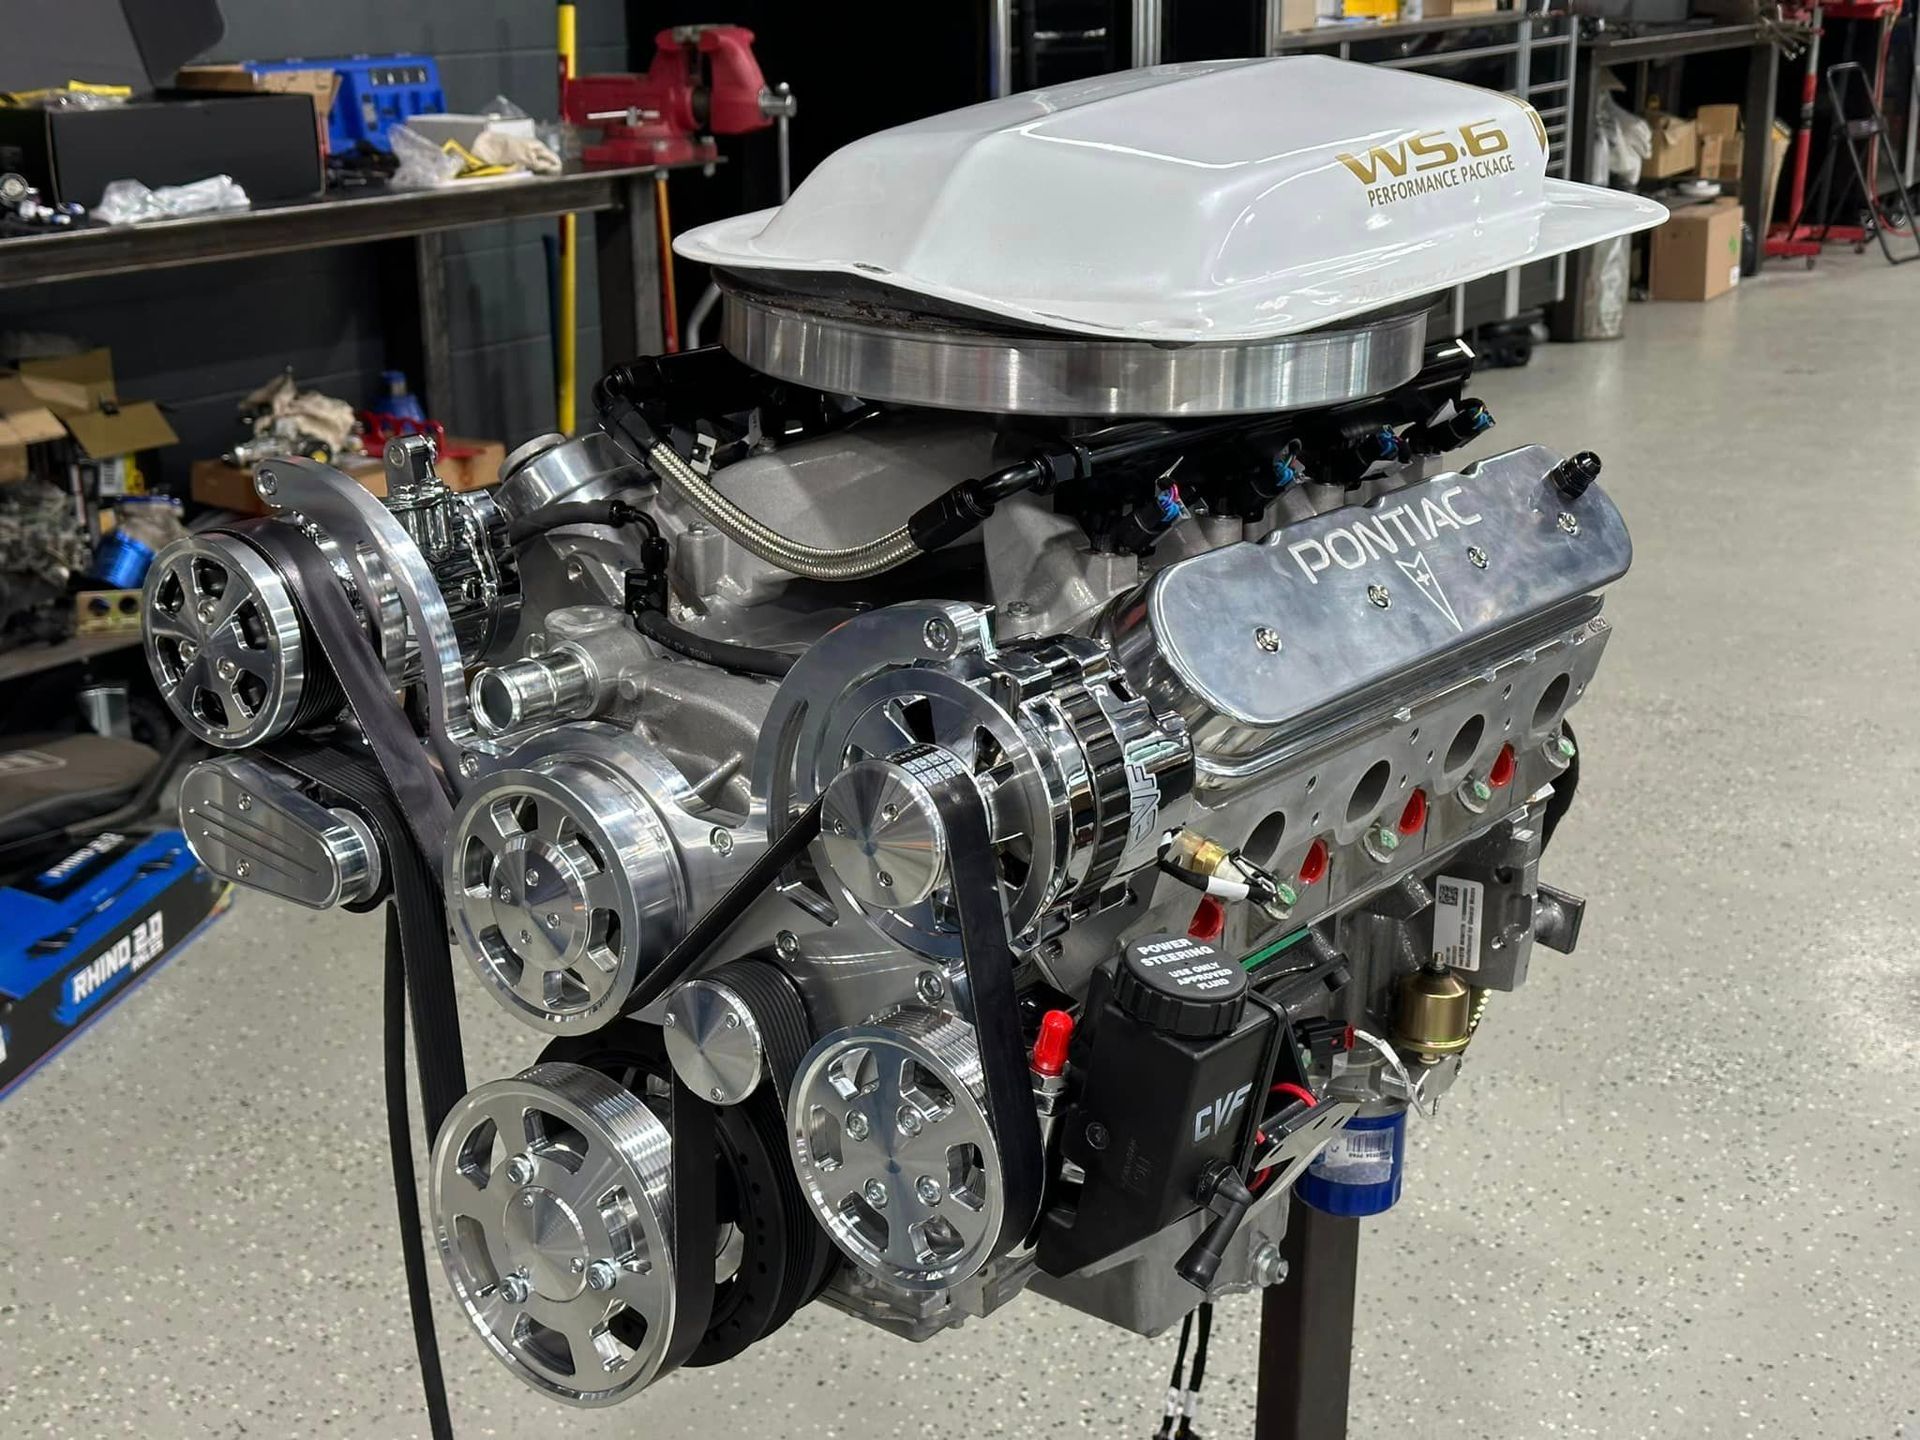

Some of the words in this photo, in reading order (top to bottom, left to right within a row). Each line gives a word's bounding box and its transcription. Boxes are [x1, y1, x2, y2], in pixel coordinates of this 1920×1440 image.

[1367, 168, 1460, 208] PERFORMANCE
[1461, 154, 1516, 185] PACKAGE
[1288, 486, 1483, 585] PONTIAC
[1137, 938, 1193, 955] POWER
[1140, 946, 1215, 967] STEERING
[72, 935, 131, 1004] RHINO
[1168, 968, 1193, 978] USE
[1191, 961, 1221, 973] ONLY
[1176, 968, 1233, 986] APPROVED
[1196, 978, 1230, 990] FLUID
[1194, 1082, 1253, 1142] CVF
